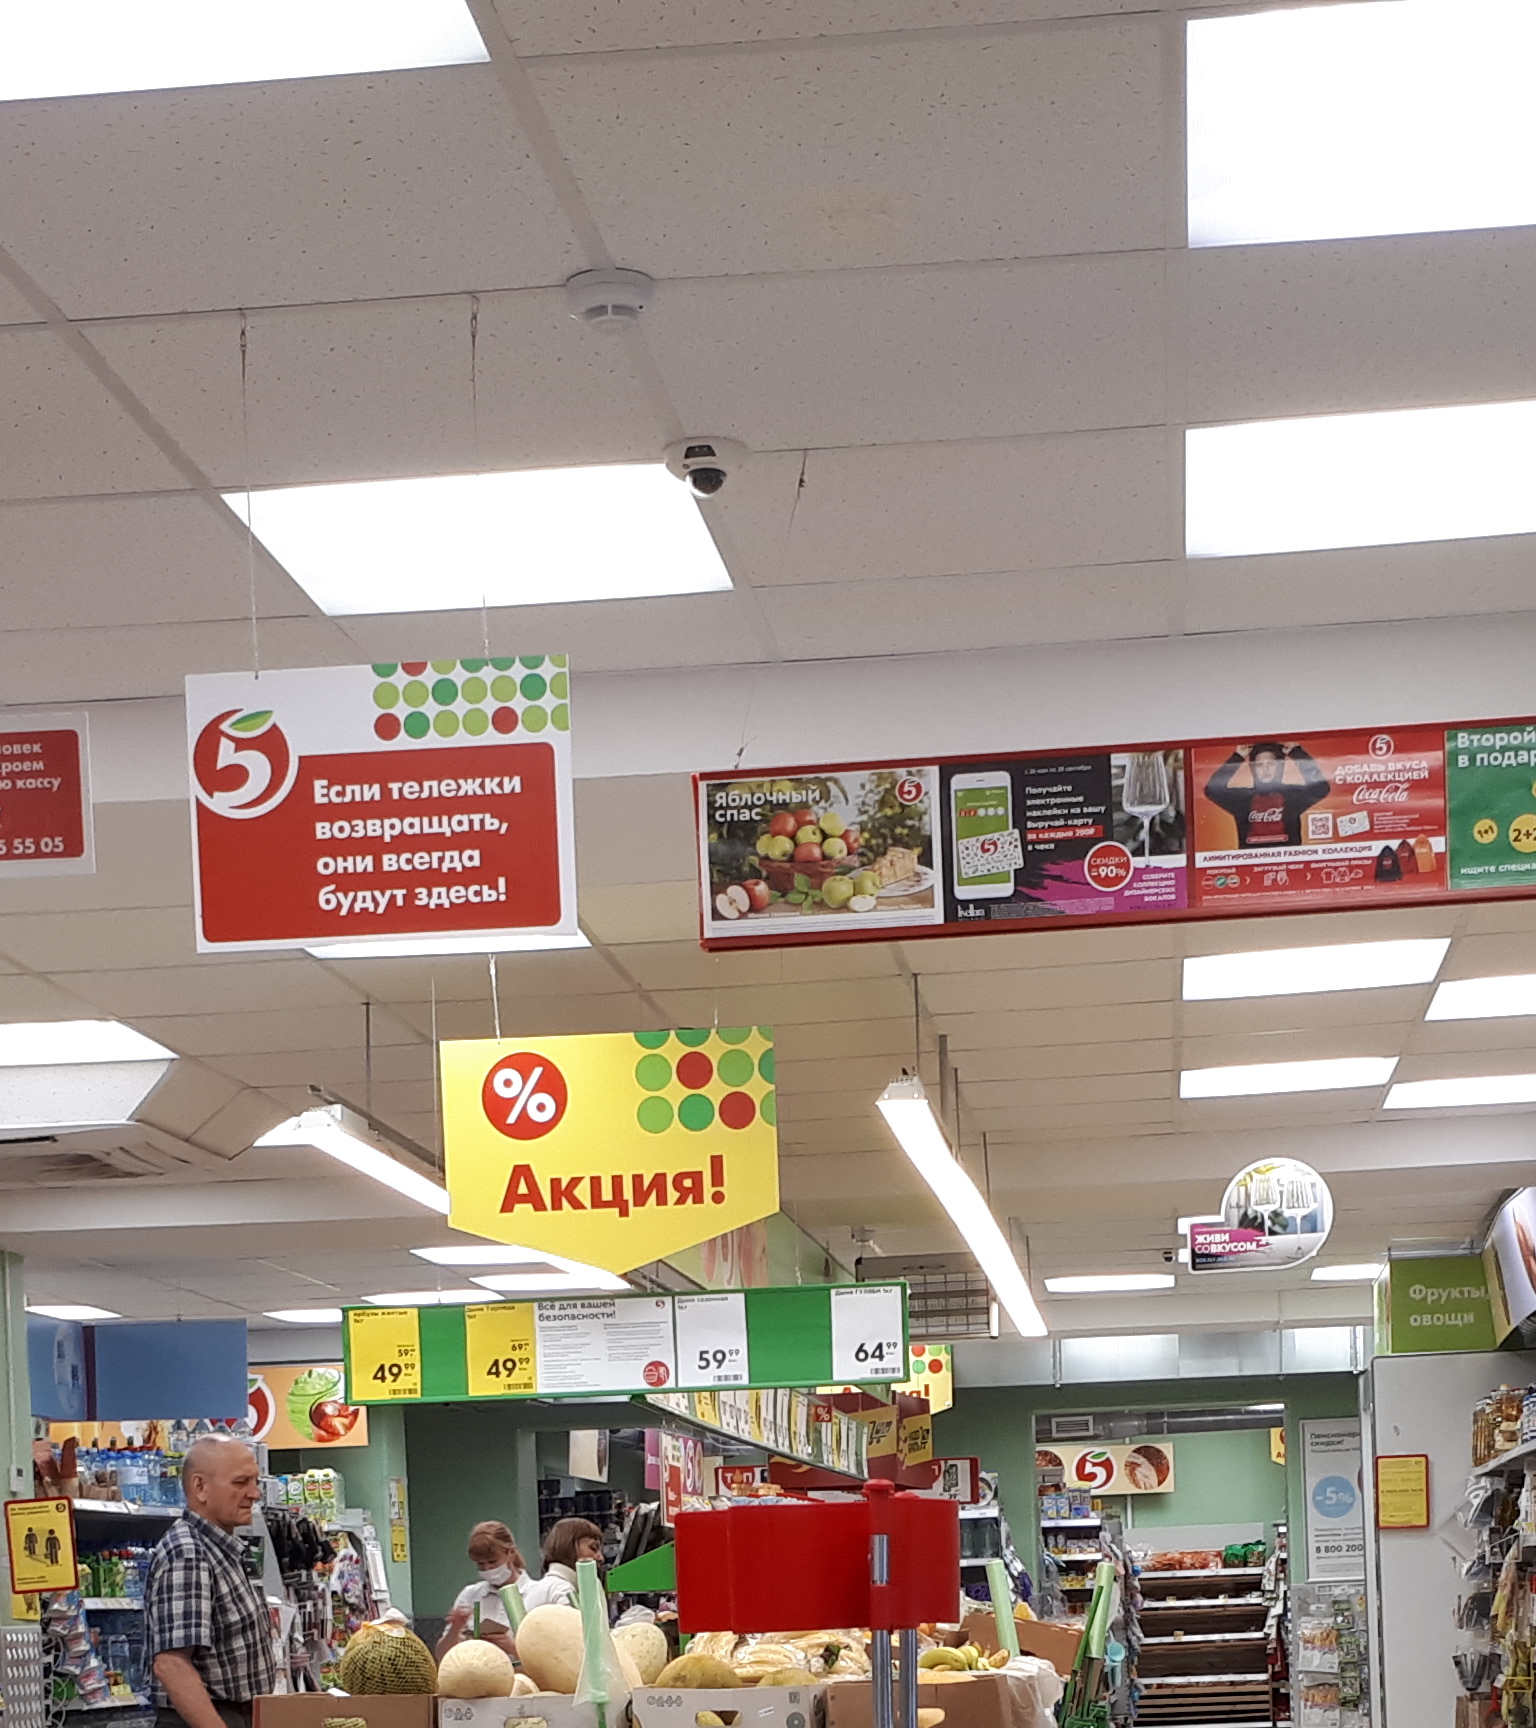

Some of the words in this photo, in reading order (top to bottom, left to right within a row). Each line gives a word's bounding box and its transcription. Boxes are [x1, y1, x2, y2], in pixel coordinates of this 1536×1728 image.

[1457, 728, 1536, 749] Второй
[1388, 760, 1428, 772] ВКУСА
[1458, 755, 1469, 768] в
[16, 777, 61, 792] кассу
[313, 779, 381, 803] Если
[388, 775, 521, 801] тележки
[715, 786, 820, 808] Яблочный
[715, 807, 761, 822] спас
[315, 812, 509, 842] возвращать,
[13, 838, 35, 854] 55
[40, 837, 64, 853] 05
[317, 855, 373, 875] они
[382, 849, 481, 873] всегда
[1091, 856, 1128, 865] СКИДКИ
[318, 884, 407, 915] будут
[414, 876, 506, 907] здесь!
[499, 1154, 726, 1219] Акция!
[1195, 1233, 1229, 1243] ЖИВИ
[558, 1302, 578, 1311] для
[580, 1299, 616, 1309] вашей
[538, 1311, 616, 1322] безопасности!
[1410, 1311, 1474, 1327] овощи
